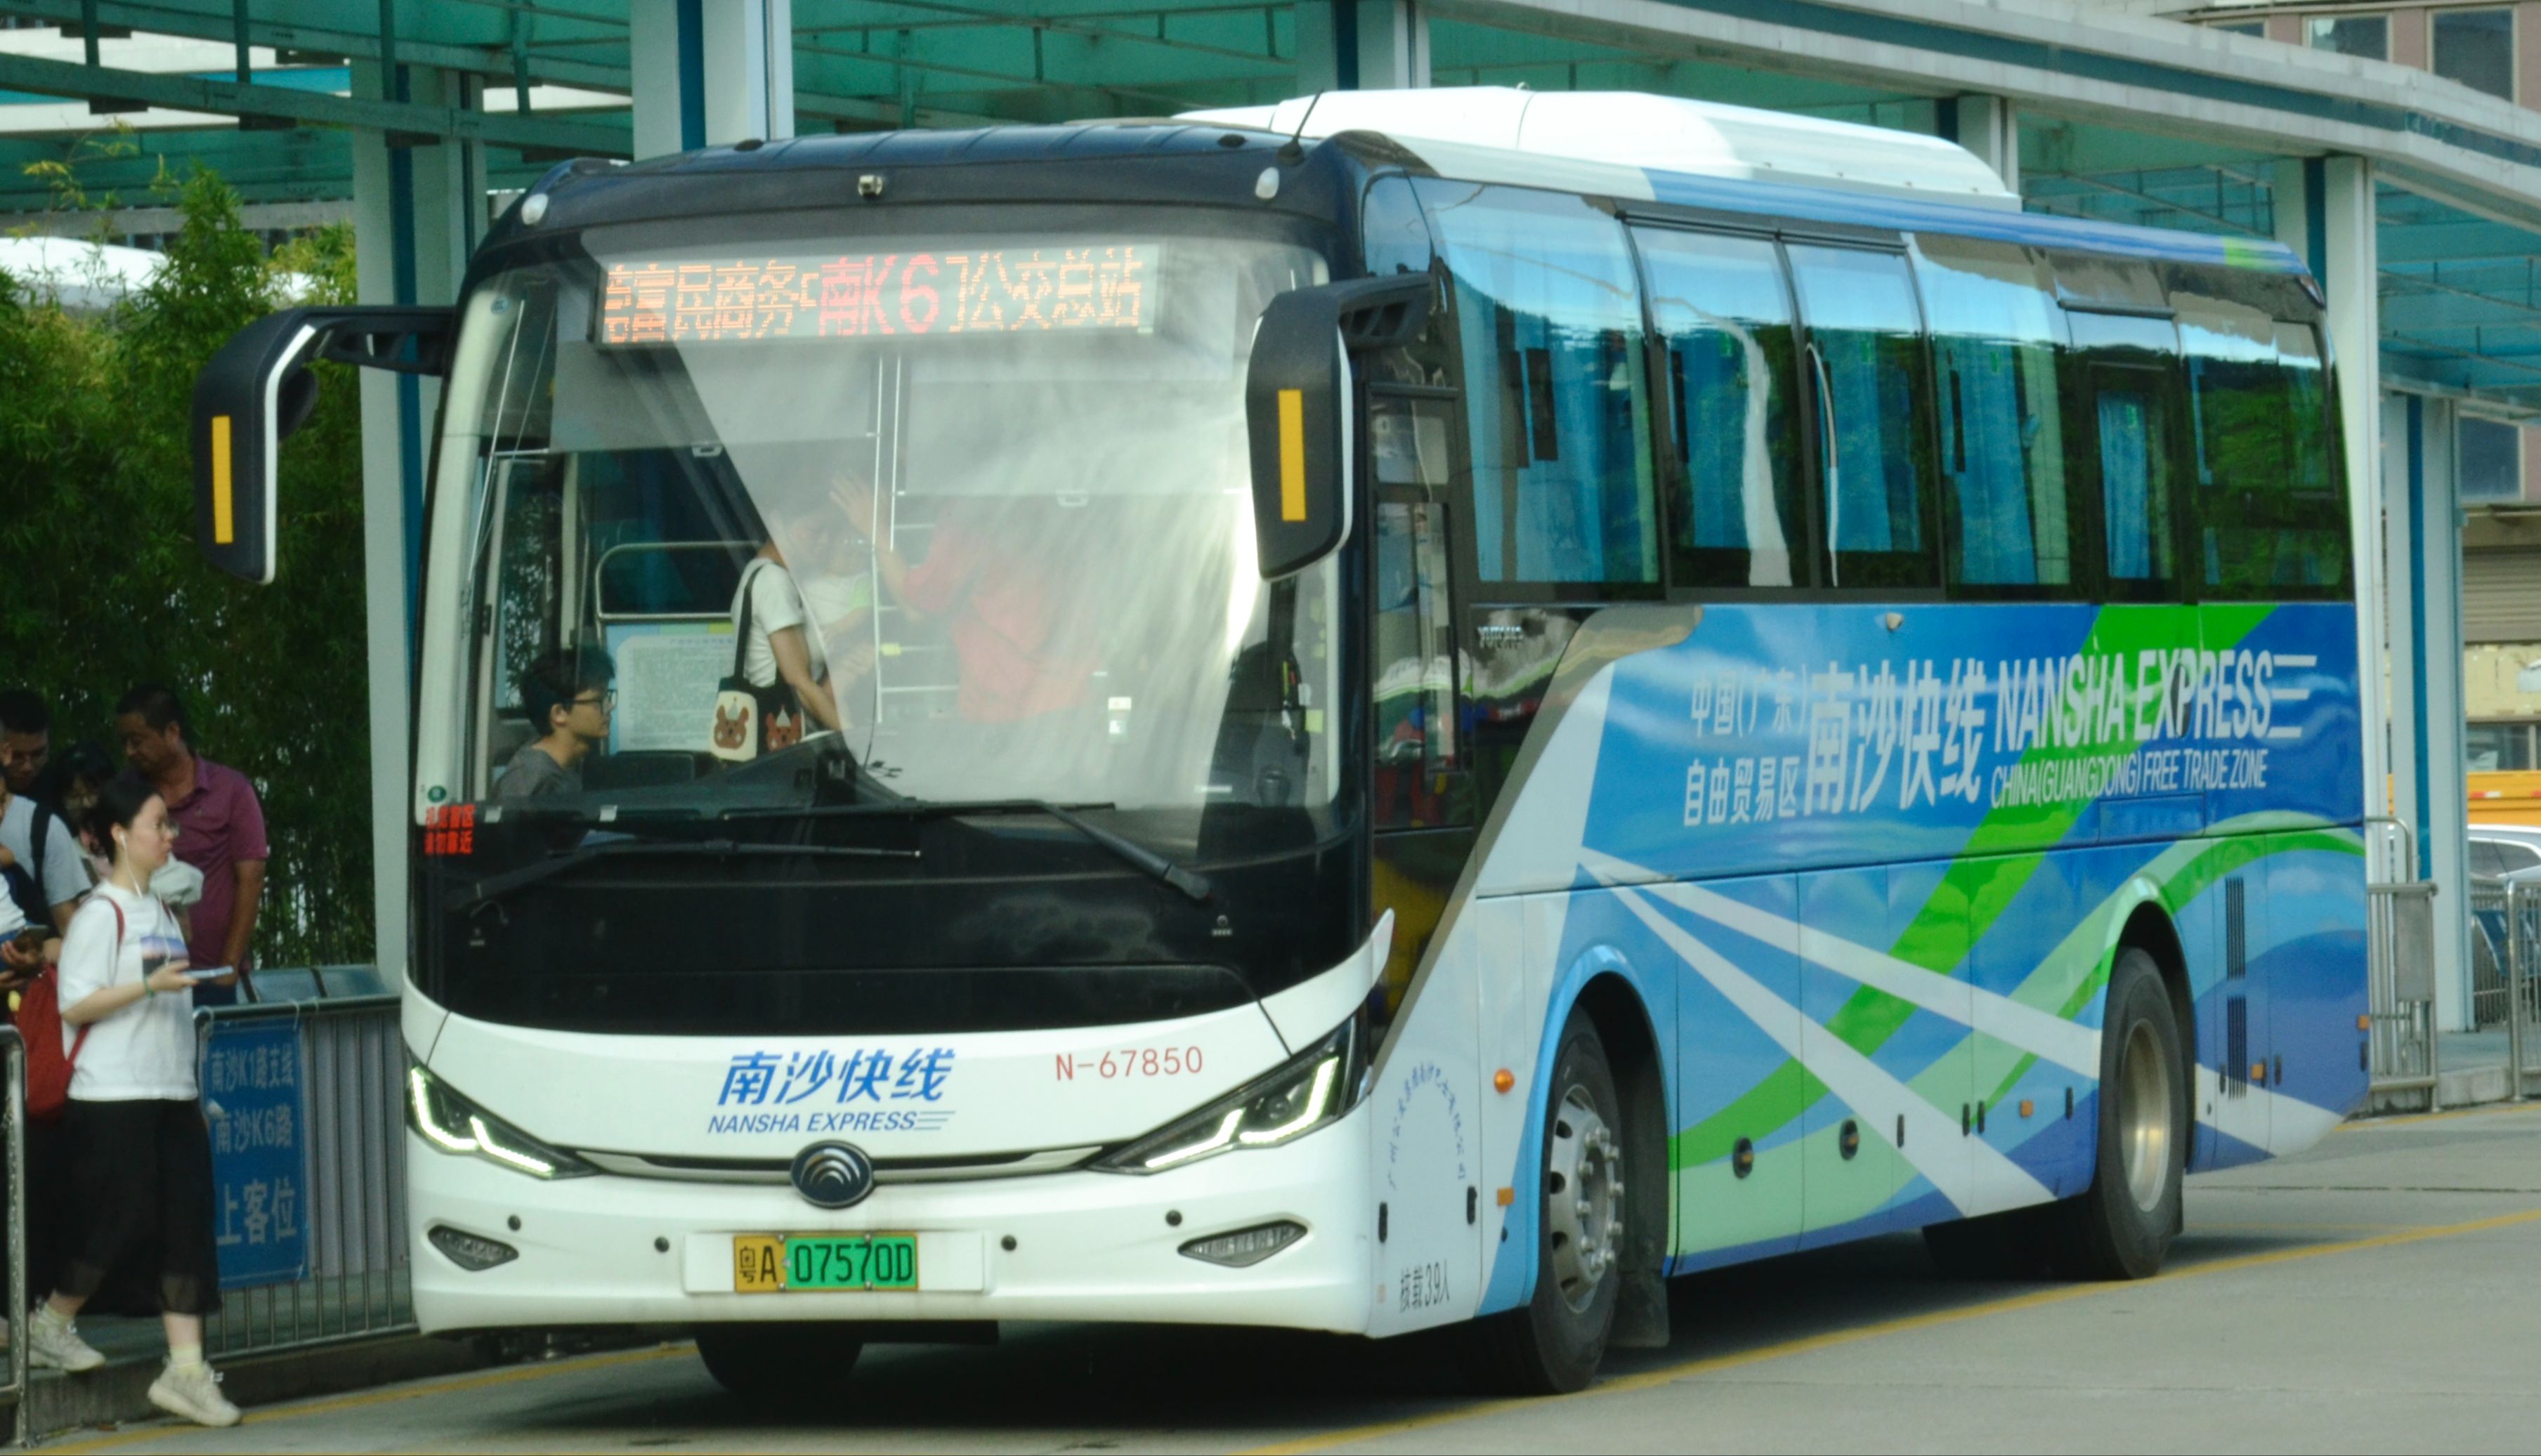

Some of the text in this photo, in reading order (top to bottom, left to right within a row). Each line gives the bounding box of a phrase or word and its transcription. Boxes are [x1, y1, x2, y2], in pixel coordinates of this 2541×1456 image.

[1994, 648, 2274, 754] NANSHA EXPRESS
[1803, 657, 1987, 816] 南沙快线
[1683, 756, 1801, 826] 自由贸易区
[2143, 750, 2181, 792] FREE
[2183, 748, 2228, 790] TRADE
[2229, 748, 2269, 789] ZONE
[717, 1047, 956, 1106] 南沙快线
[1055, 1045, 1203, 1081] N-67850
[707, 1110, 918, 1134] NANSHA EXPRESS
[216, 1175, 297, 1246] 上客位
